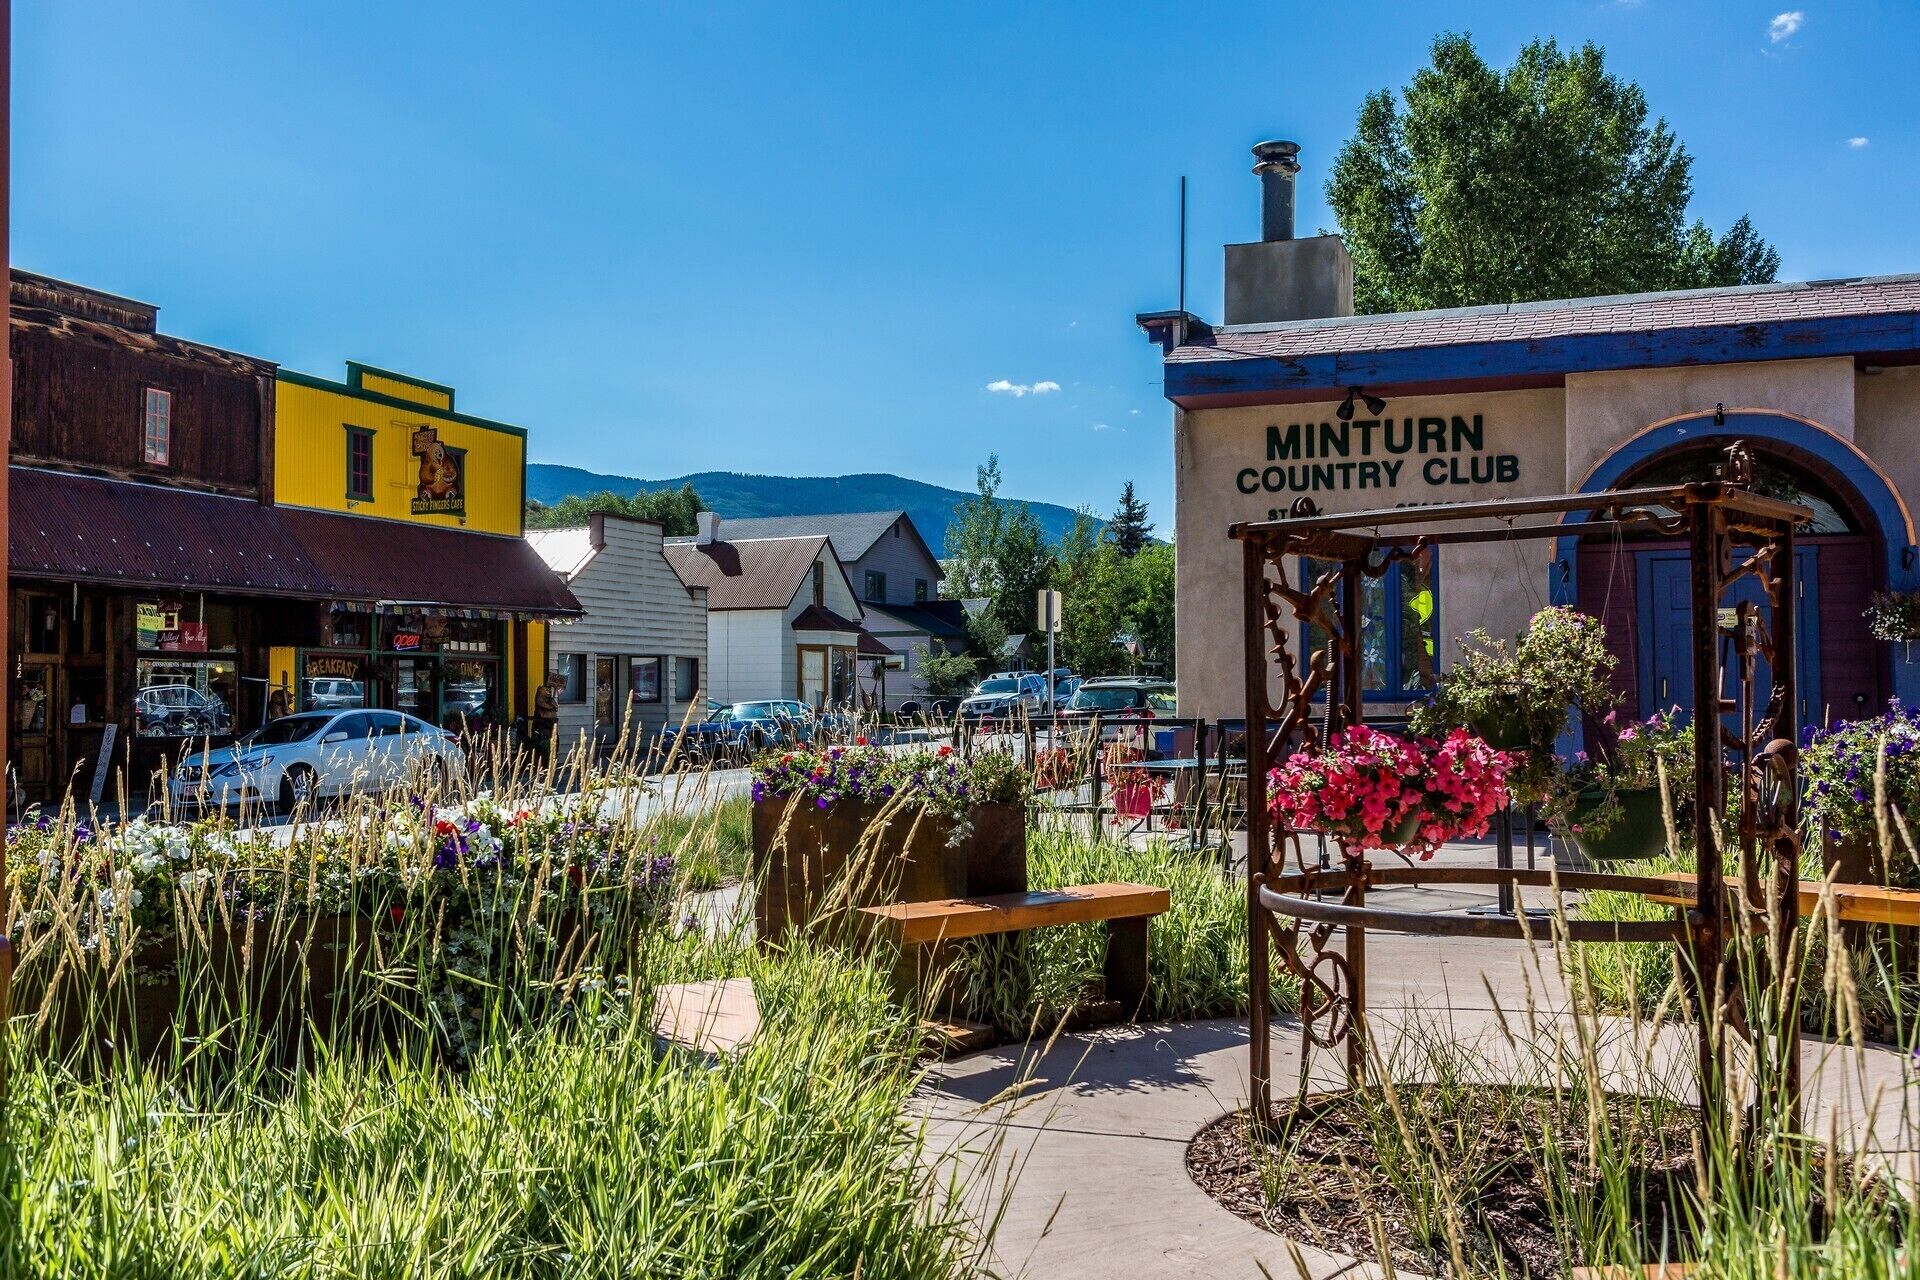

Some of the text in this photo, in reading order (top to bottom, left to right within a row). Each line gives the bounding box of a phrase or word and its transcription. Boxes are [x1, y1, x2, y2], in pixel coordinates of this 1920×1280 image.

[1266, 415, 1484, 461] MINTURN
[1236, 454, 1520, 495] COUNTRY CLUB
[413, 498, 464, 512] STICKY FINGERS CAFE
[307, 658, 358, 679] BREAKFAST
